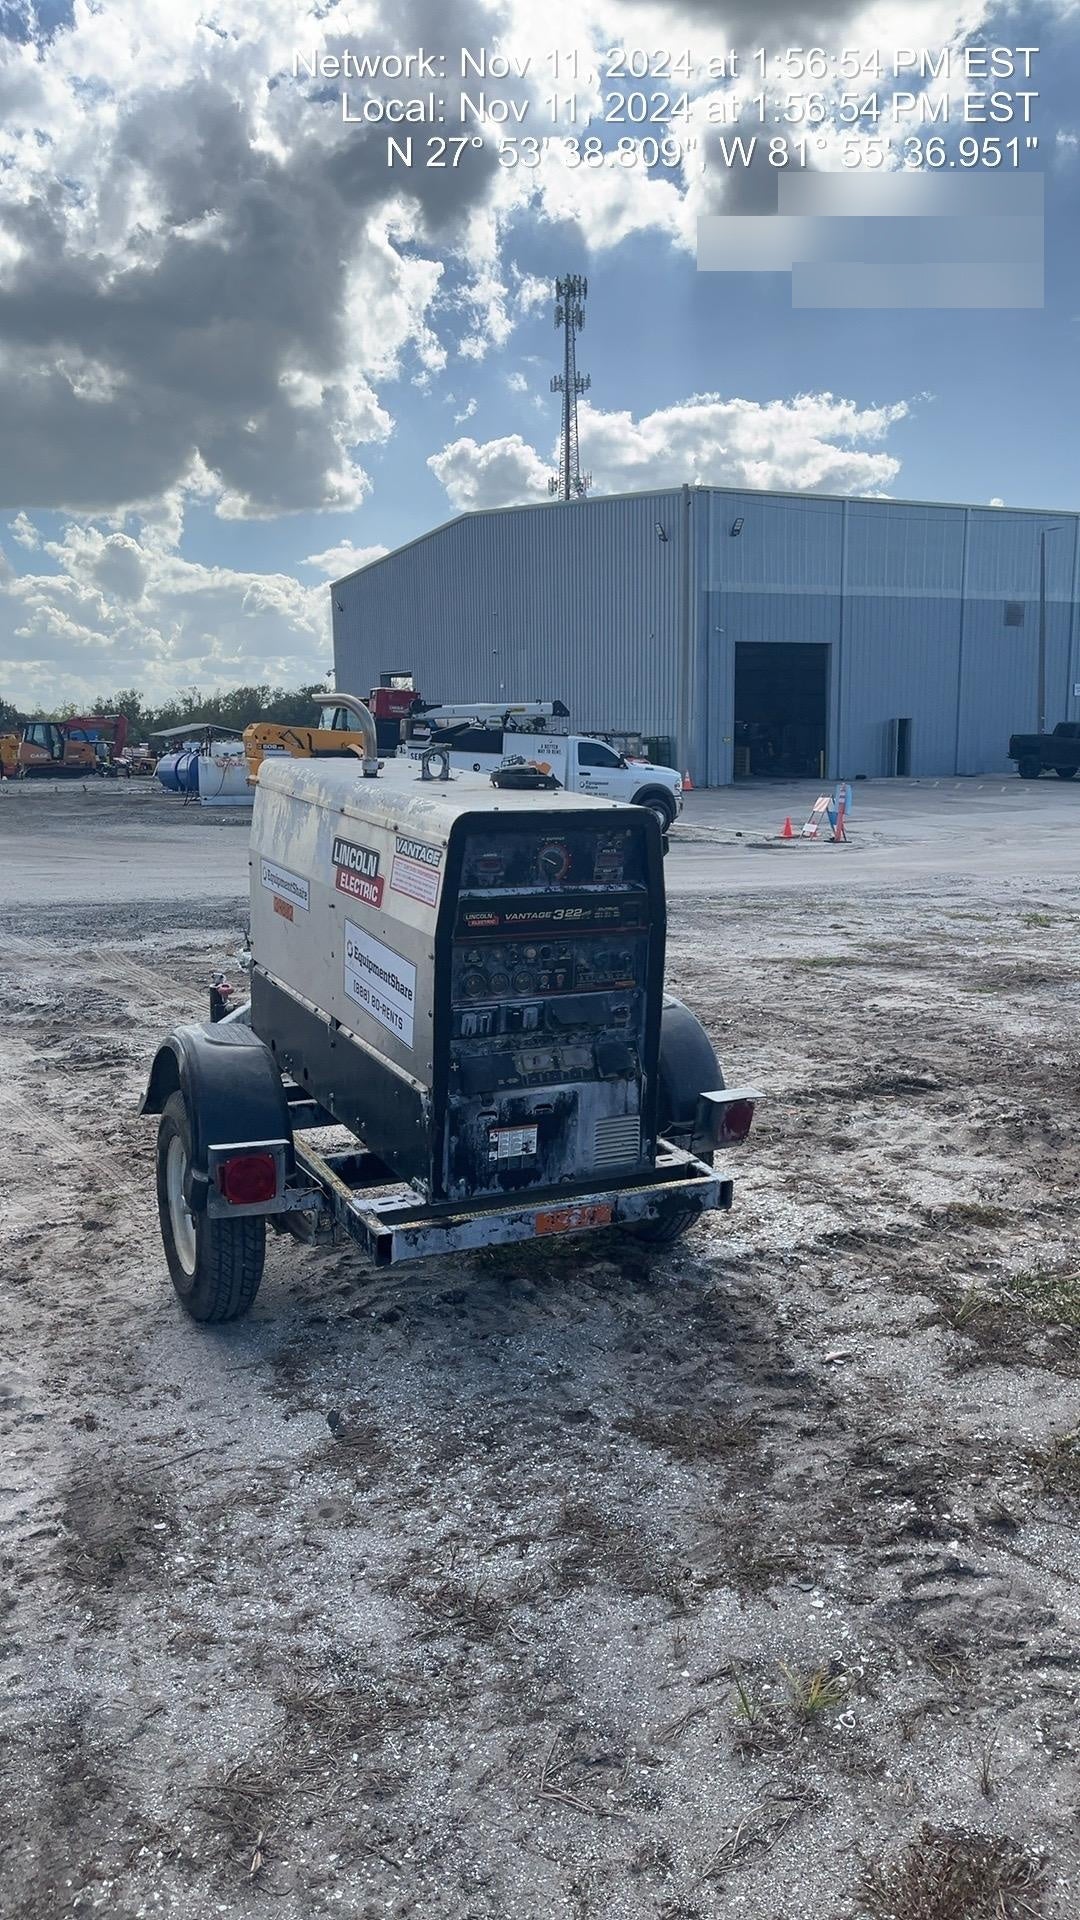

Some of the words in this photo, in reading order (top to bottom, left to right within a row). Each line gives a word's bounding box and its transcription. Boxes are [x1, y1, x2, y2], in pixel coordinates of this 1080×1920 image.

[333, 841, 378, 878] LINCOLN
[396, 837, 441, 867] VANTAGE
[340, 871, 379, 903] ELECTRIC
[505, 911, 553, 920] VANTAGE
[552, 908, 583, 920] 322
[353, 945, 414, 1002] EquipmentShare
[353, 979, 371, 1005] (888)
[371, 994, 404, 1031] 80-RENTS
